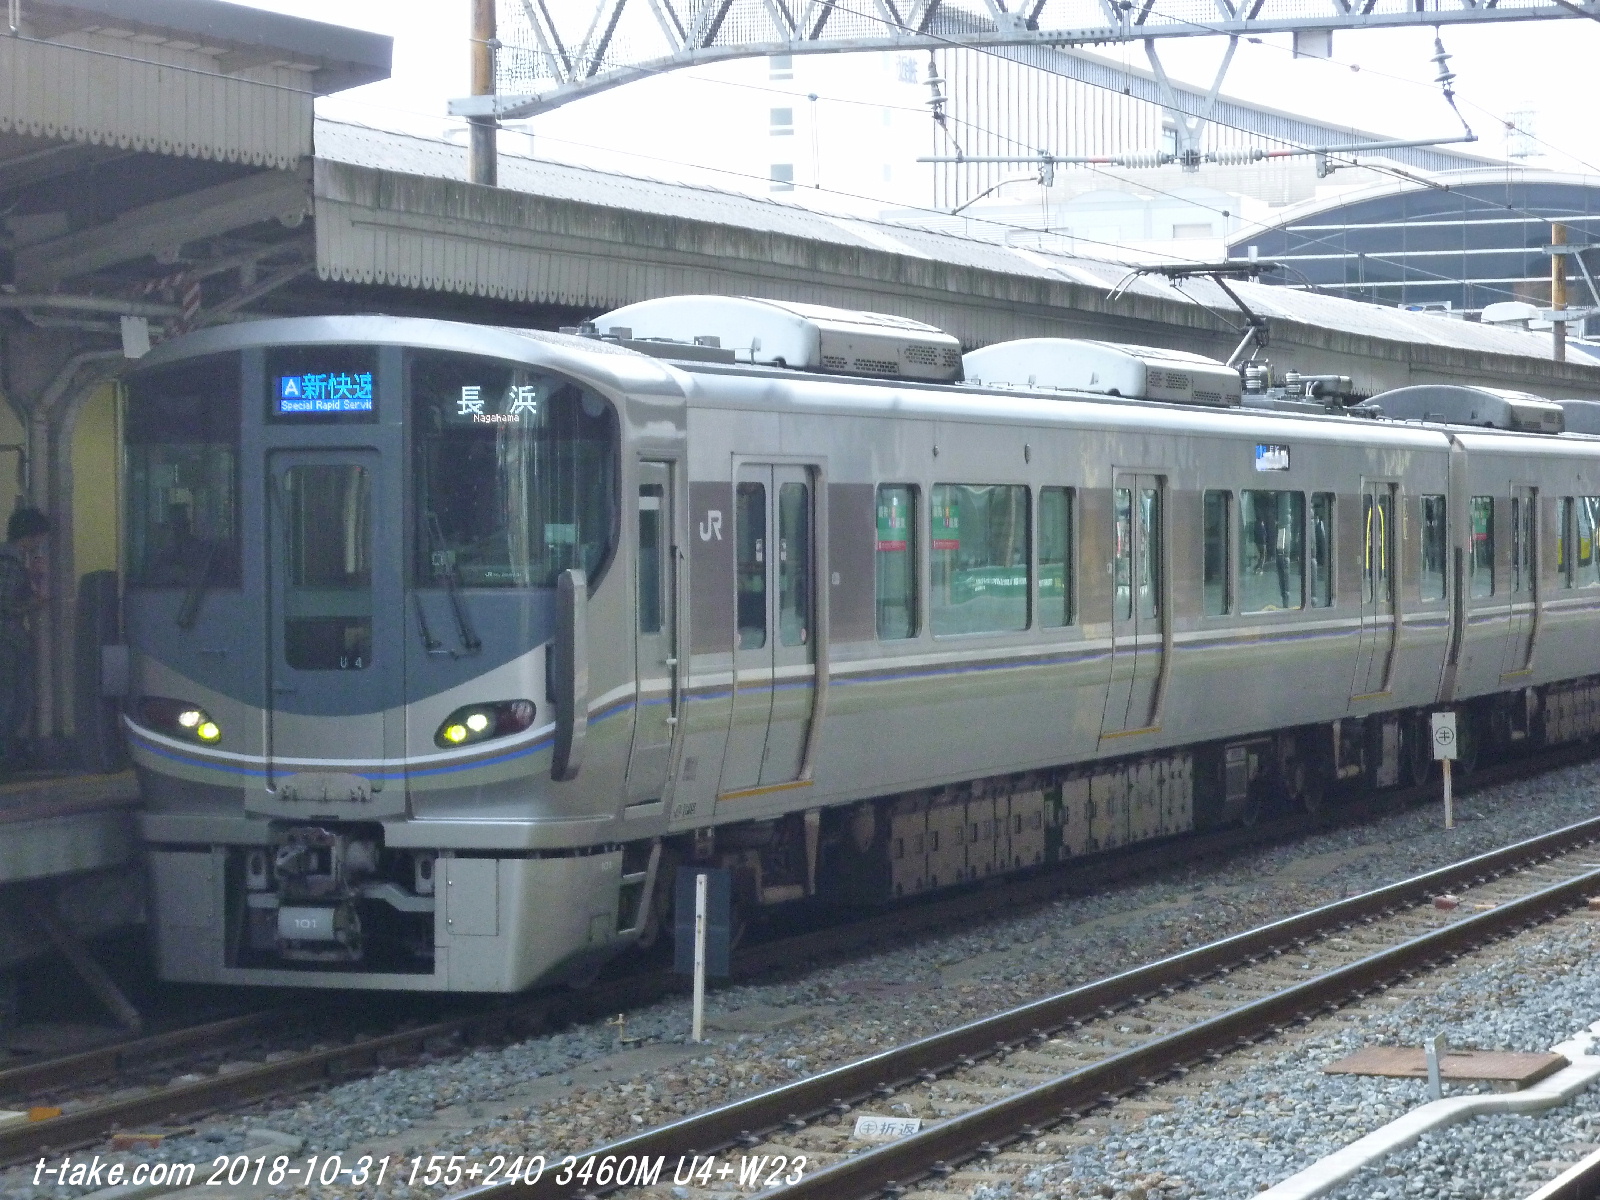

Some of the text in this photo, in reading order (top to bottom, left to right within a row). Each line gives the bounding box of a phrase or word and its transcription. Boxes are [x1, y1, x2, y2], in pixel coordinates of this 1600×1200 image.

[284, 372, 372, 399] A 新快速
[281, 401, 313, 411] Special
[316, 401, 340, 411] Rapid
[473, 413, 520, 424] Nagahama
[700, 510, 722, 541] JR
[294, 918, 318, 929] 101
